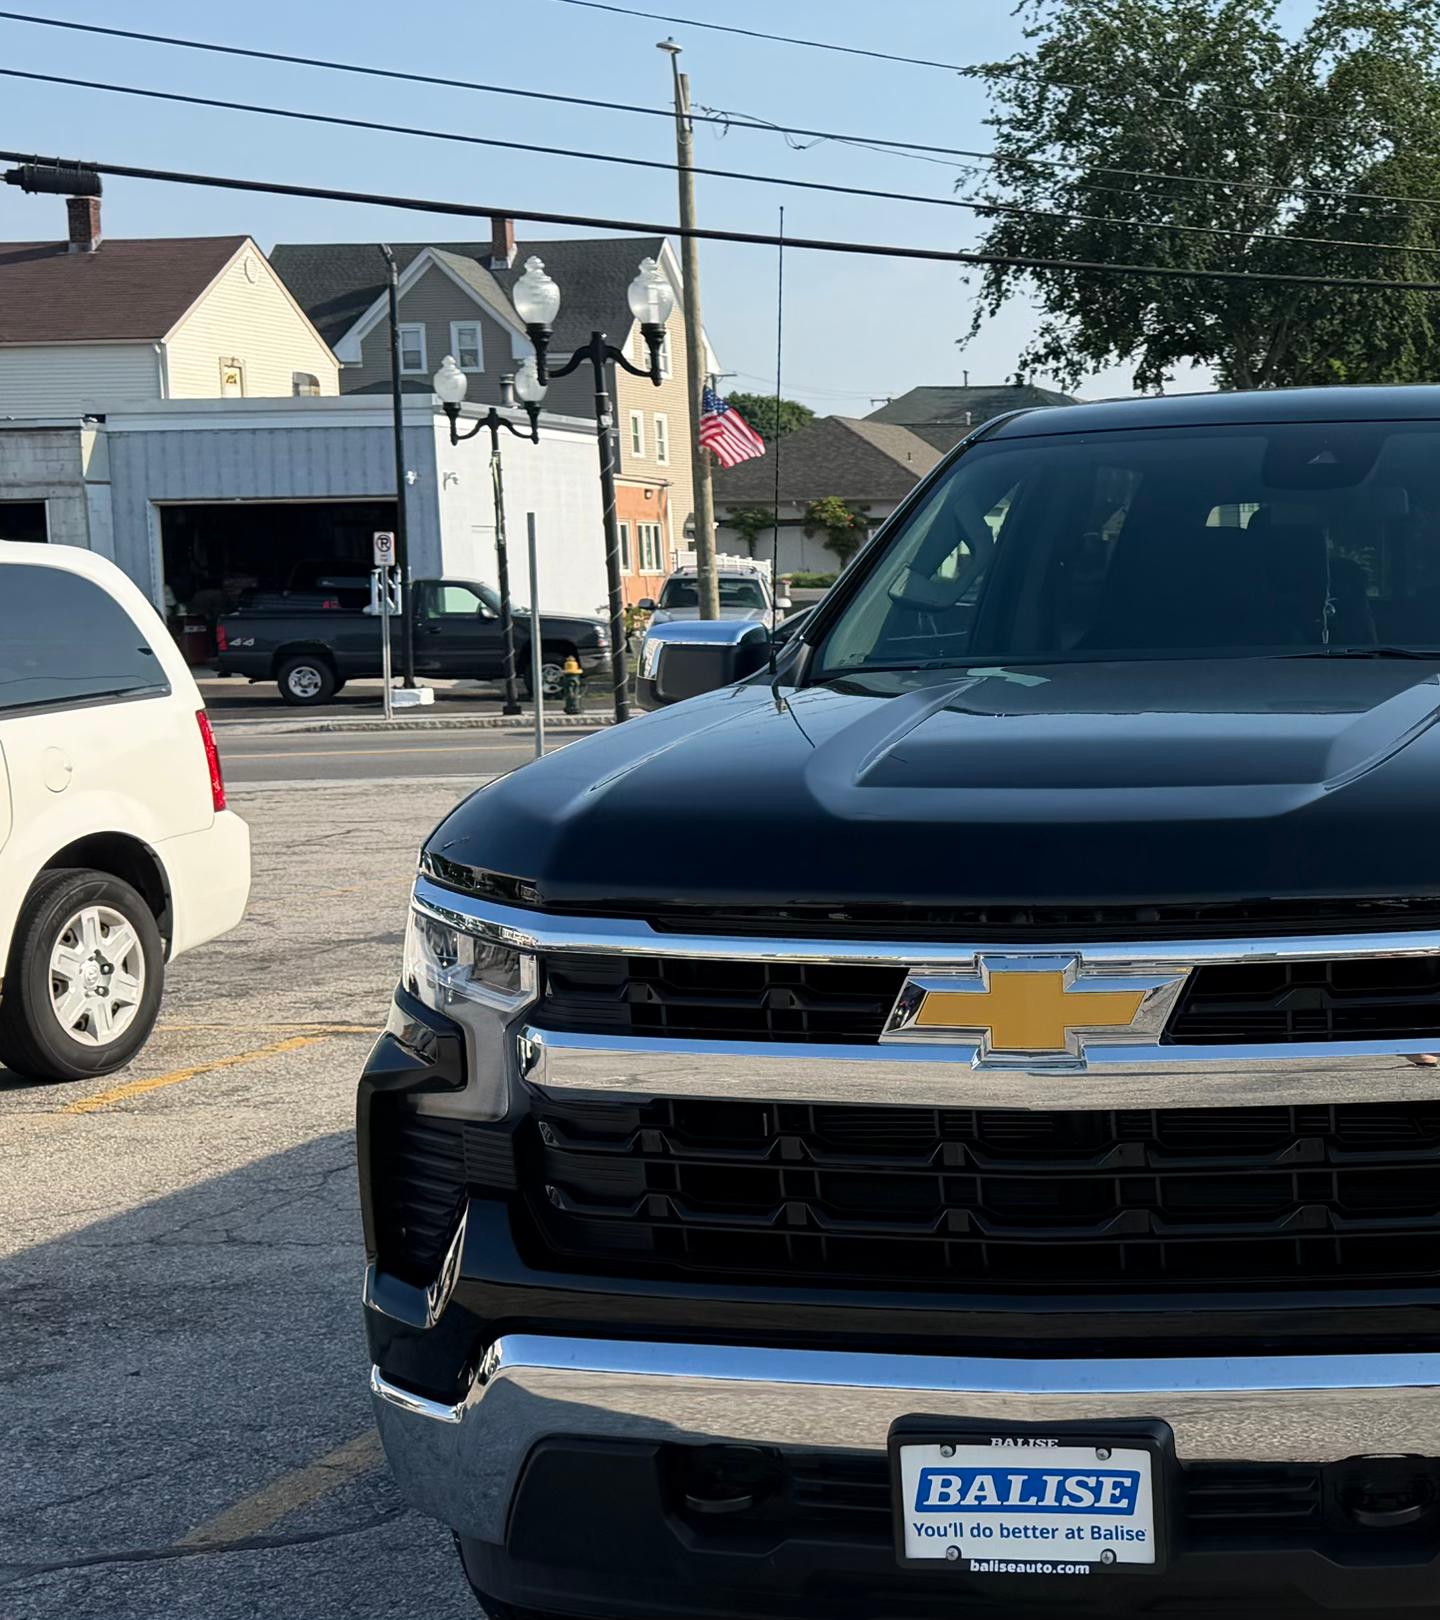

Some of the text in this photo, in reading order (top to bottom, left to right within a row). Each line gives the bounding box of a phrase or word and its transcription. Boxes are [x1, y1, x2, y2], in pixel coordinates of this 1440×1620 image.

[990, 1437, 1059, 1448] BALISE
[923, 1474, 1133, 1509] BALISE
[912, 1522, 1147, 1542] You'll do better at Balise
[970, 1559, 1090, 1575] baliseauto.com
